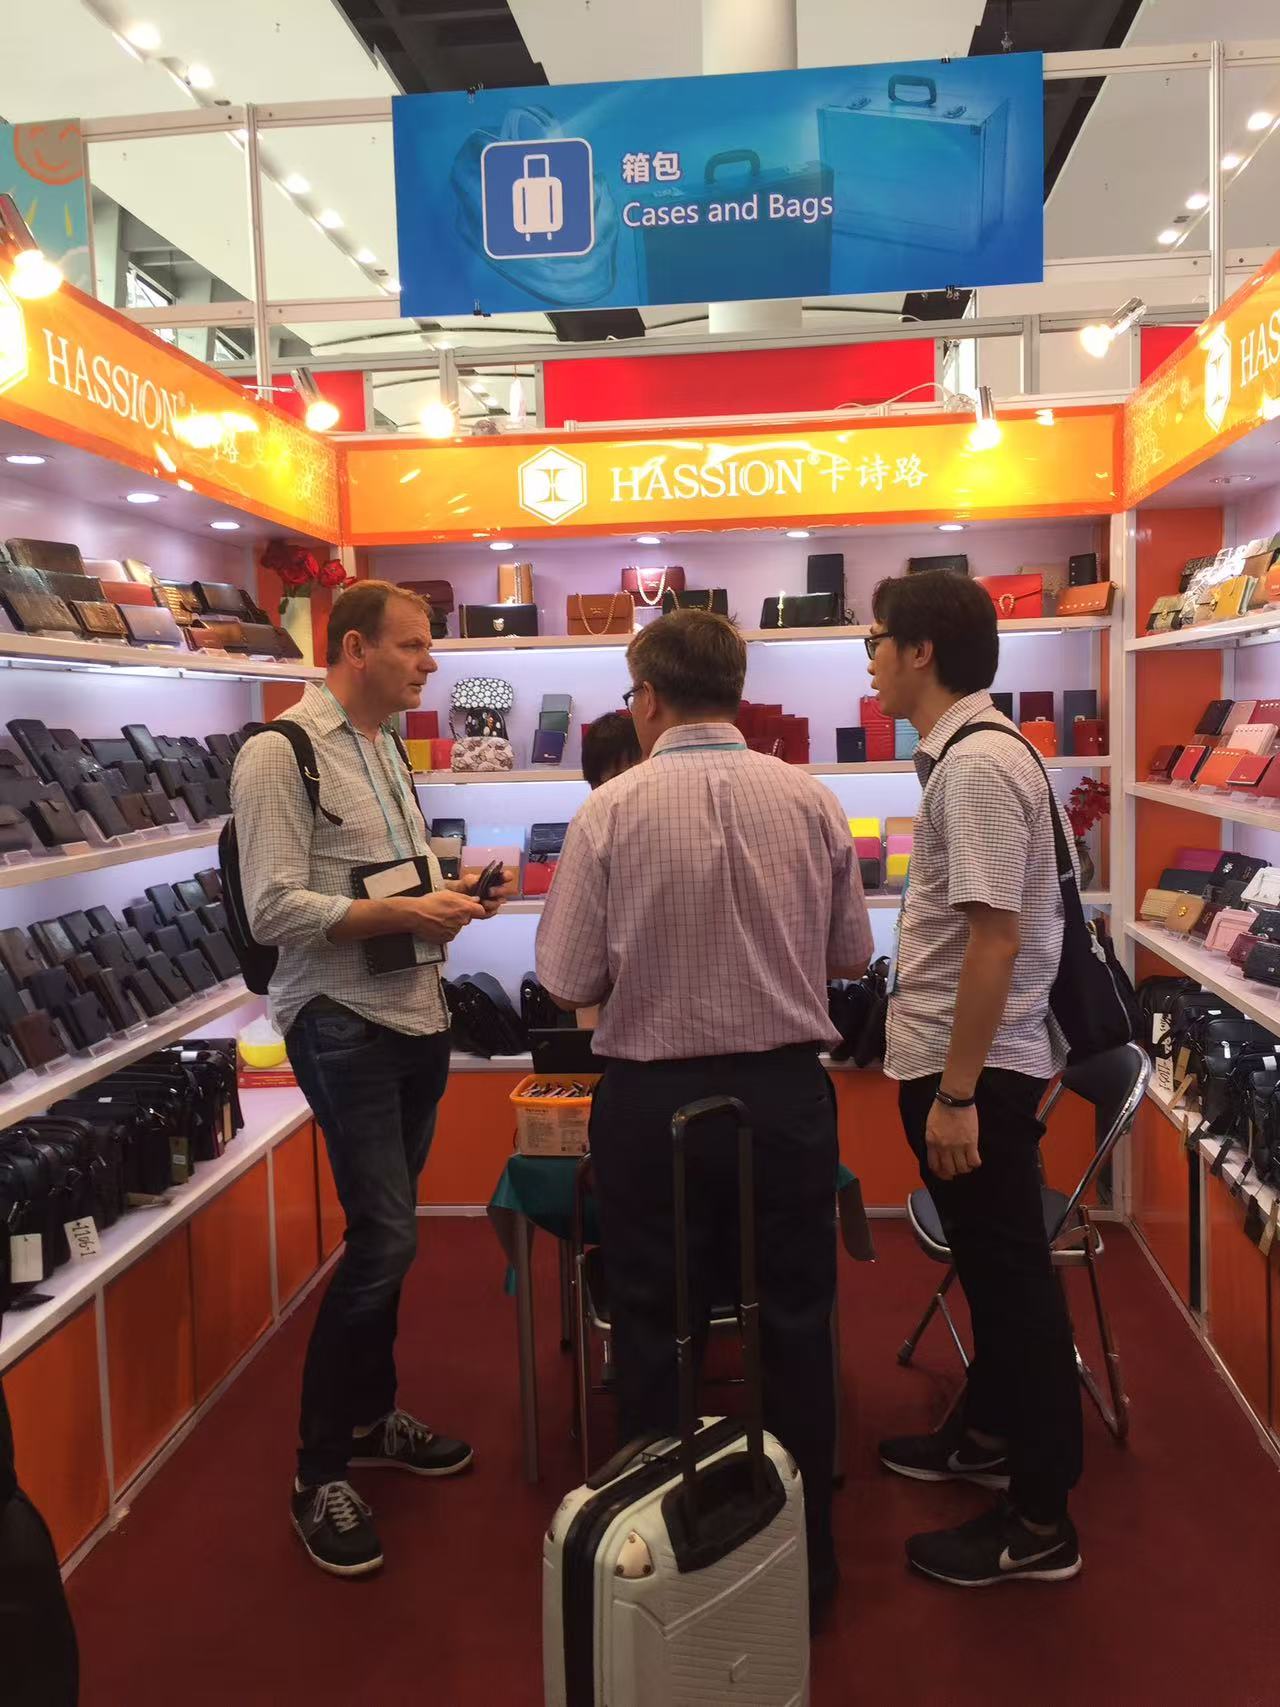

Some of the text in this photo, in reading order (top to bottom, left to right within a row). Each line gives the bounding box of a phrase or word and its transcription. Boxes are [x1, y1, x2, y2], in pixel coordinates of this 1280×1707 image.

[621, 151, 682, 184] 箱包
[622, 194, 833, 228] Cases and Bags
[820, 453, 929, 493] 卡诗路
